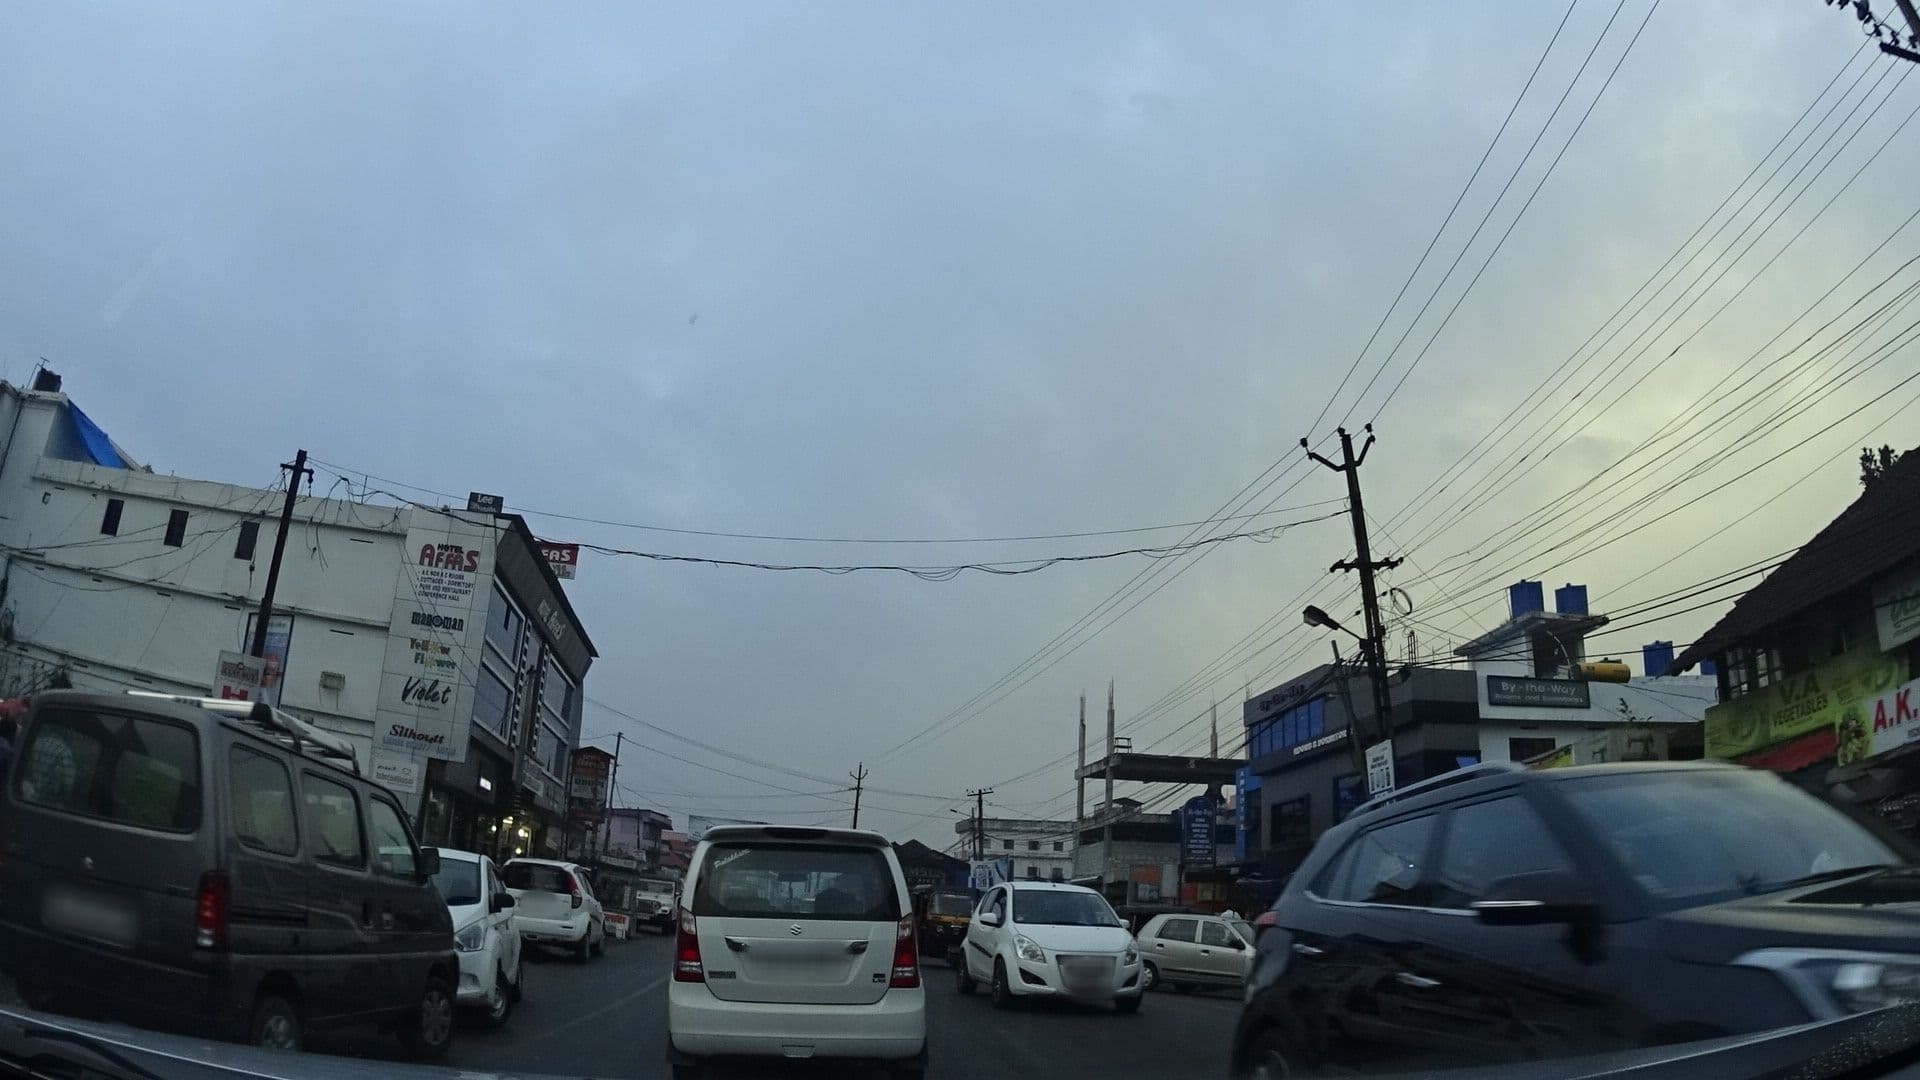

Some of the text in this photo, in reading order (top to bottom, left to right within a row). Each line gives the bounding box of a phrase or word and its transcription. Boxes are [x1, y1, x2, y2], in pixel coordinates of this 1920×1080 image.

[437, 543, 465, 554] HOTEL
[418, 590, 447, 600] CONFERENCE
[442, 586, 471, 595] RESTAURANT
[401, 676, 452, 704] Violet
[1773, 693, 1828, 727] VEGETABLES
